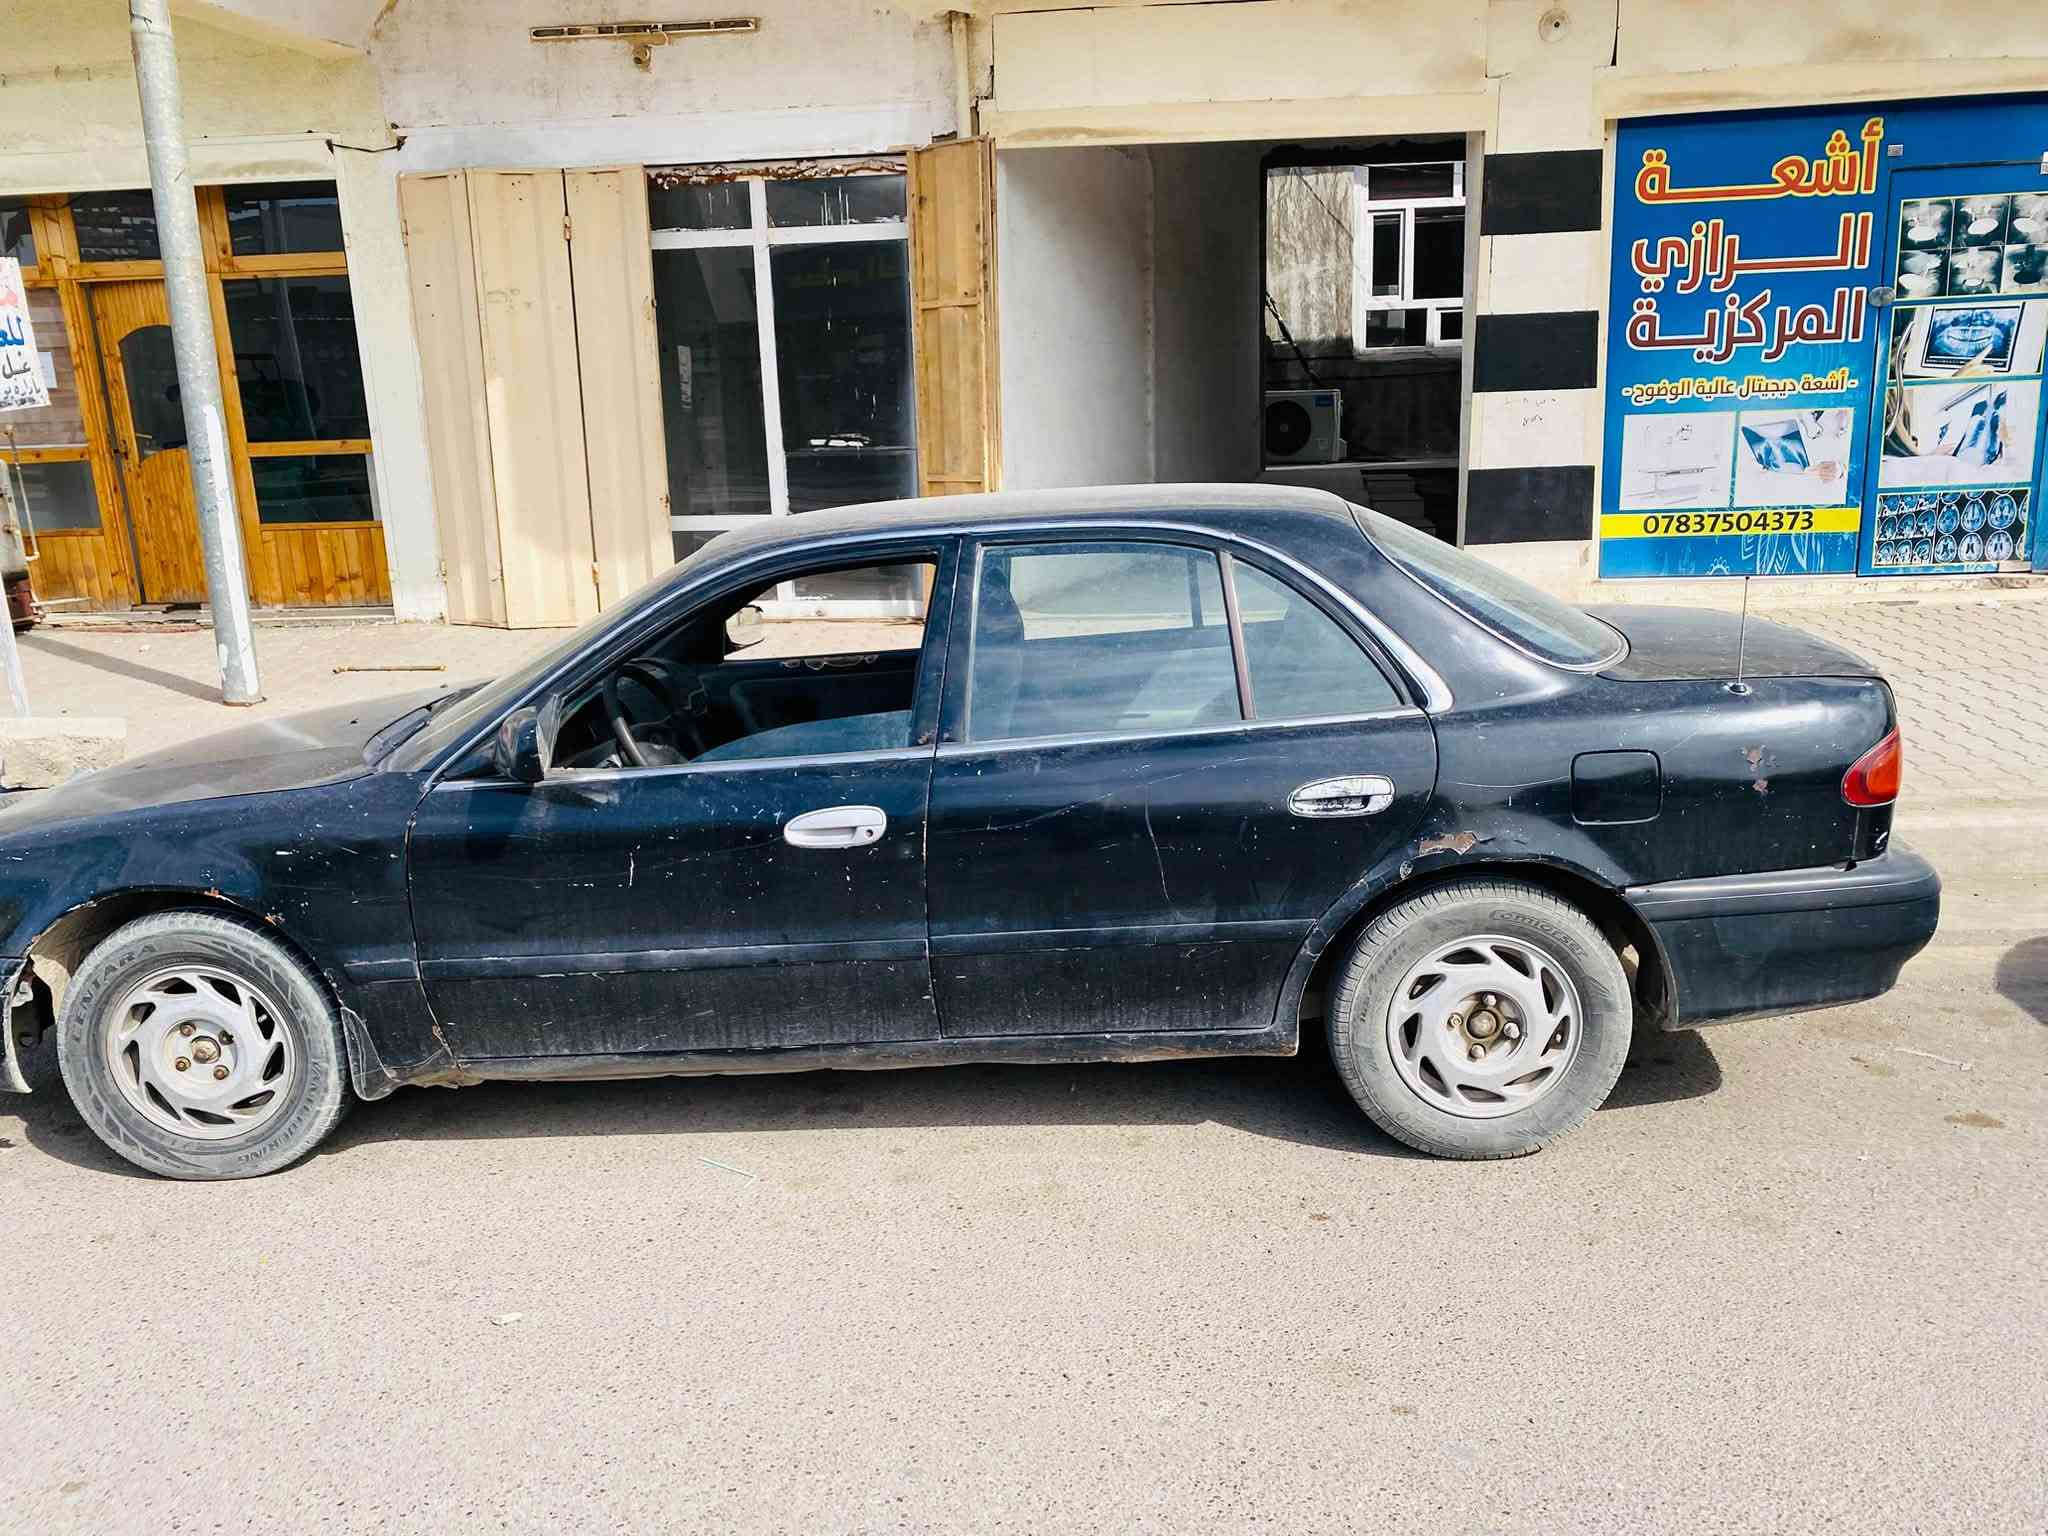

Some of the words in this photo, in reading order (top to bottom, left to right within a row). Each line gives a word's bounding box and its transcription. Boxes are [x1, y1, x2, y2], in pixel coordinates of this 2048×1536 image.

[1635, 117, 1884, 204] أشعة
[1631, 212, 1873, 293] الرازي
[1626, 287, 1867, 363] المركزية
[1695, 378, 1735, 400] عالية
[1739, 376, 1797, 399] ديجيتال
[1642, 510, 1815, 535] 07837504373
